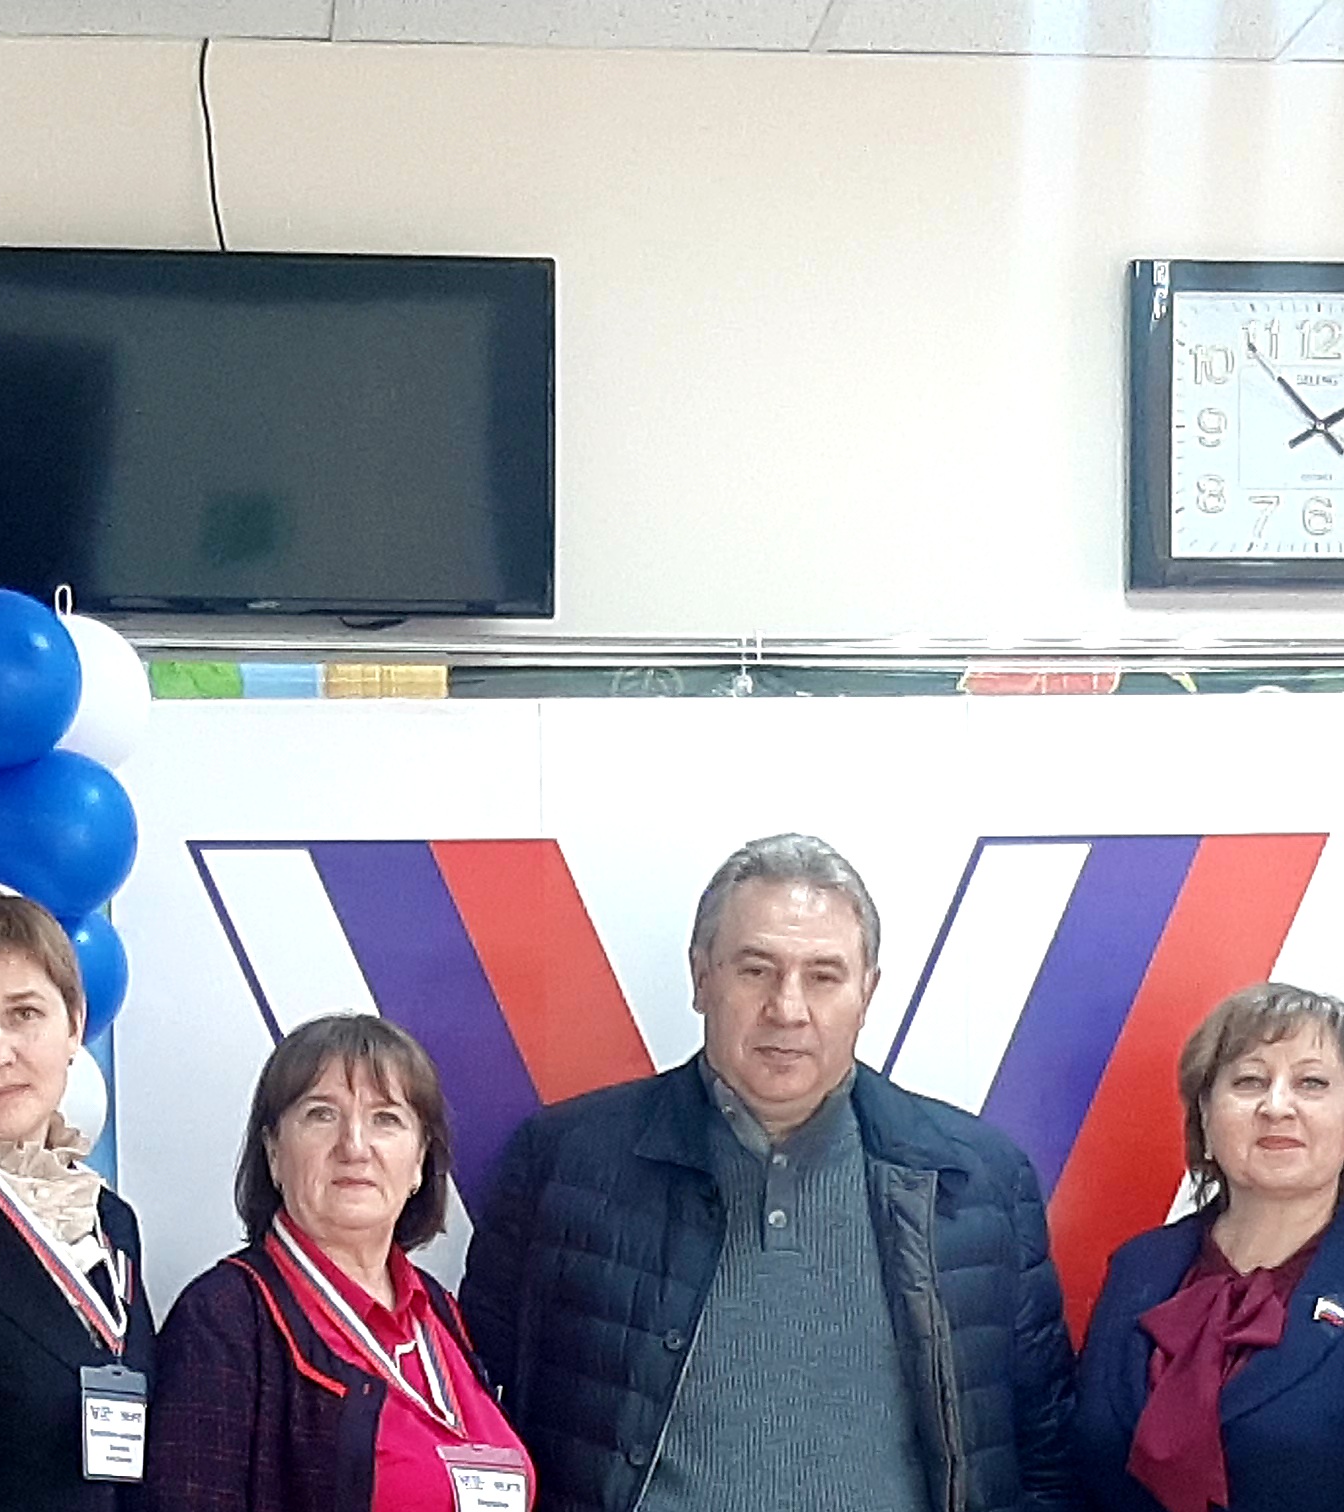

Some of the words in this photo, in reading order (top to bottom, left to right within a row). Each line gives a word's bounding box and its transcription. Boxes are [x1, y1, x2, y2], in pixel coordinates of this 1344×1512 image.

[1242, 318, 1281, 360] 11
[1296, 318, 1342, 360] 12
[1189, 344, 1235, 386] 10
[1197, 407, 1228, 448] 9
[1196, 473, 1227, 514] 8
[1249, 495, 1280, 539] 7
[1301, 496, 1333, 536] 6
